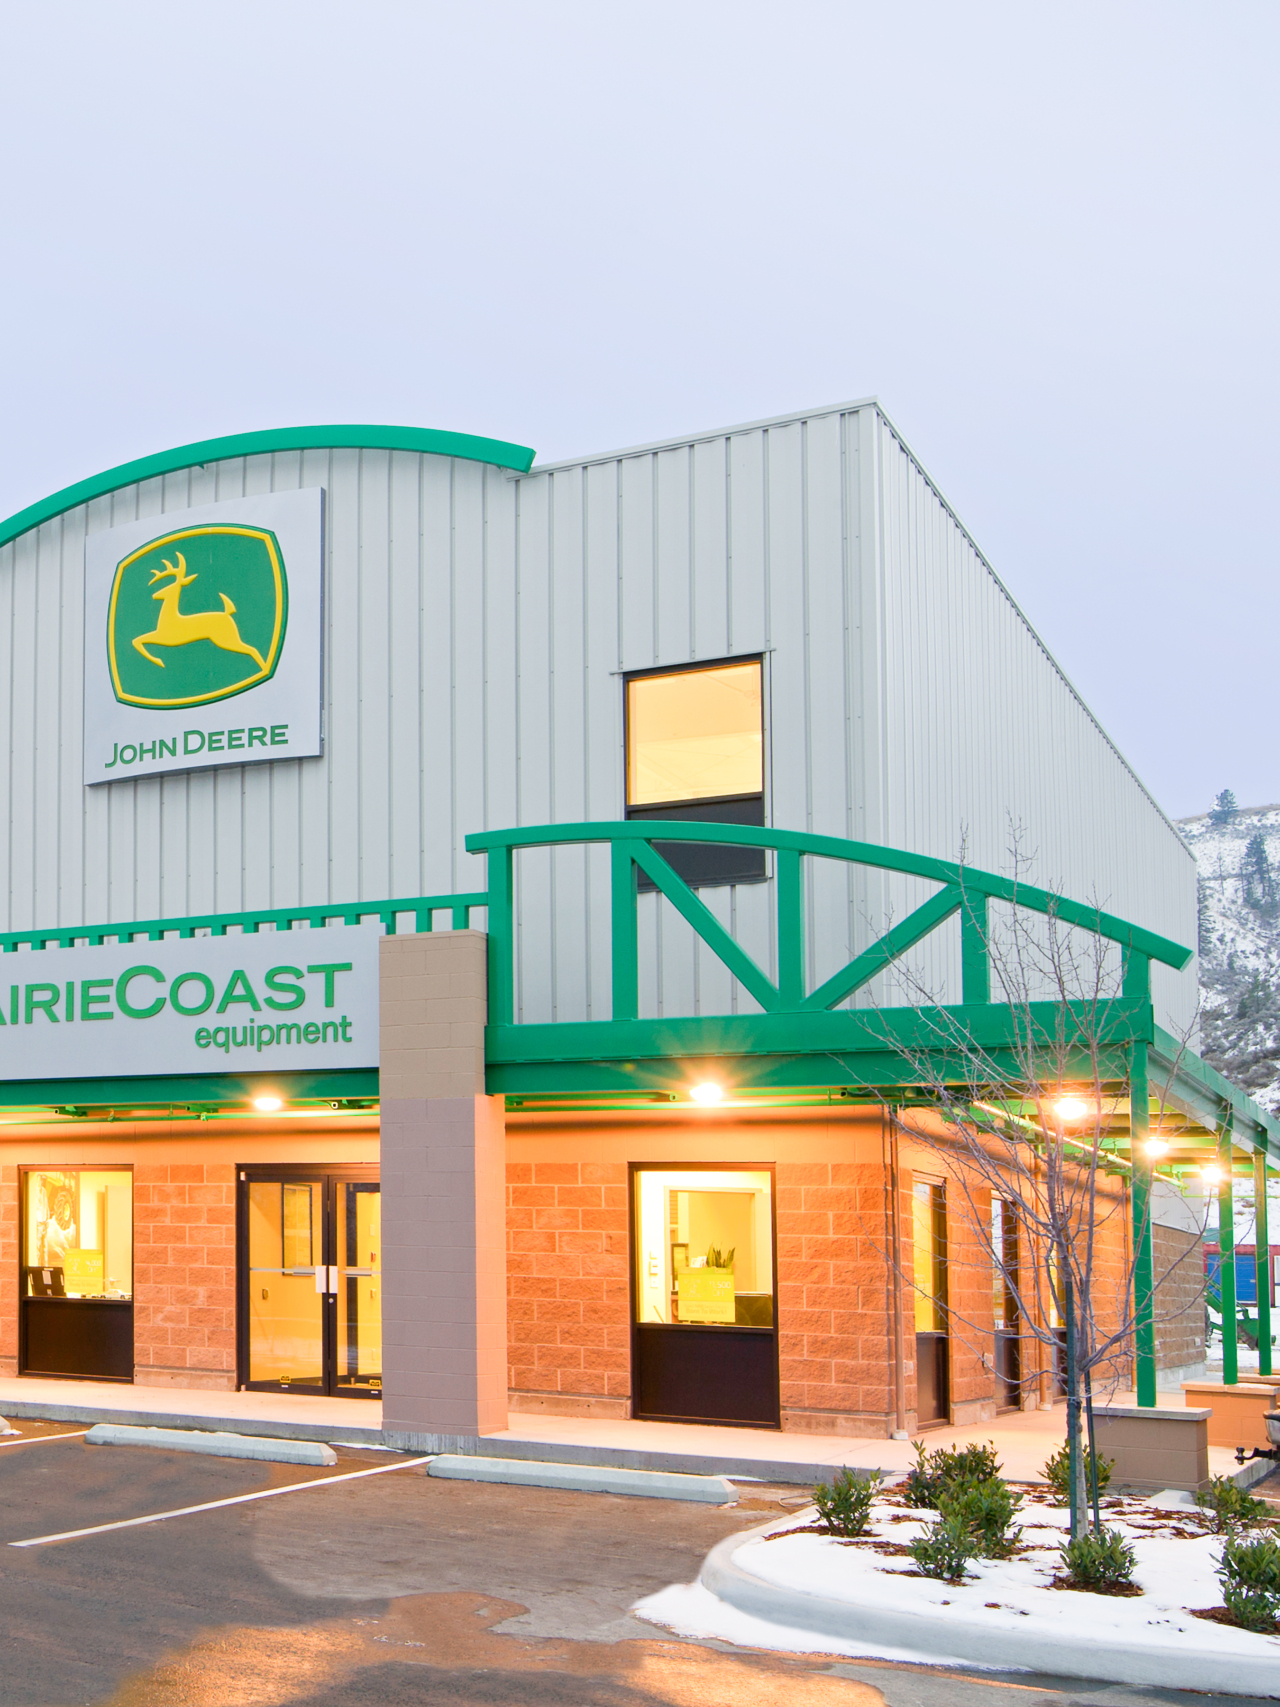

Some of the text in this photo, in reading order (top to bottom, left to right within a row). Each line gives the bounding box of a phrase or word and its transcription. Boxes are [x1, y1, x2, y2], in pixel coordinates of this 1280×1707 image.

[104, 724, 289, 769] JOHN DEERE
[194, 1014, 353, 1053] equipment
